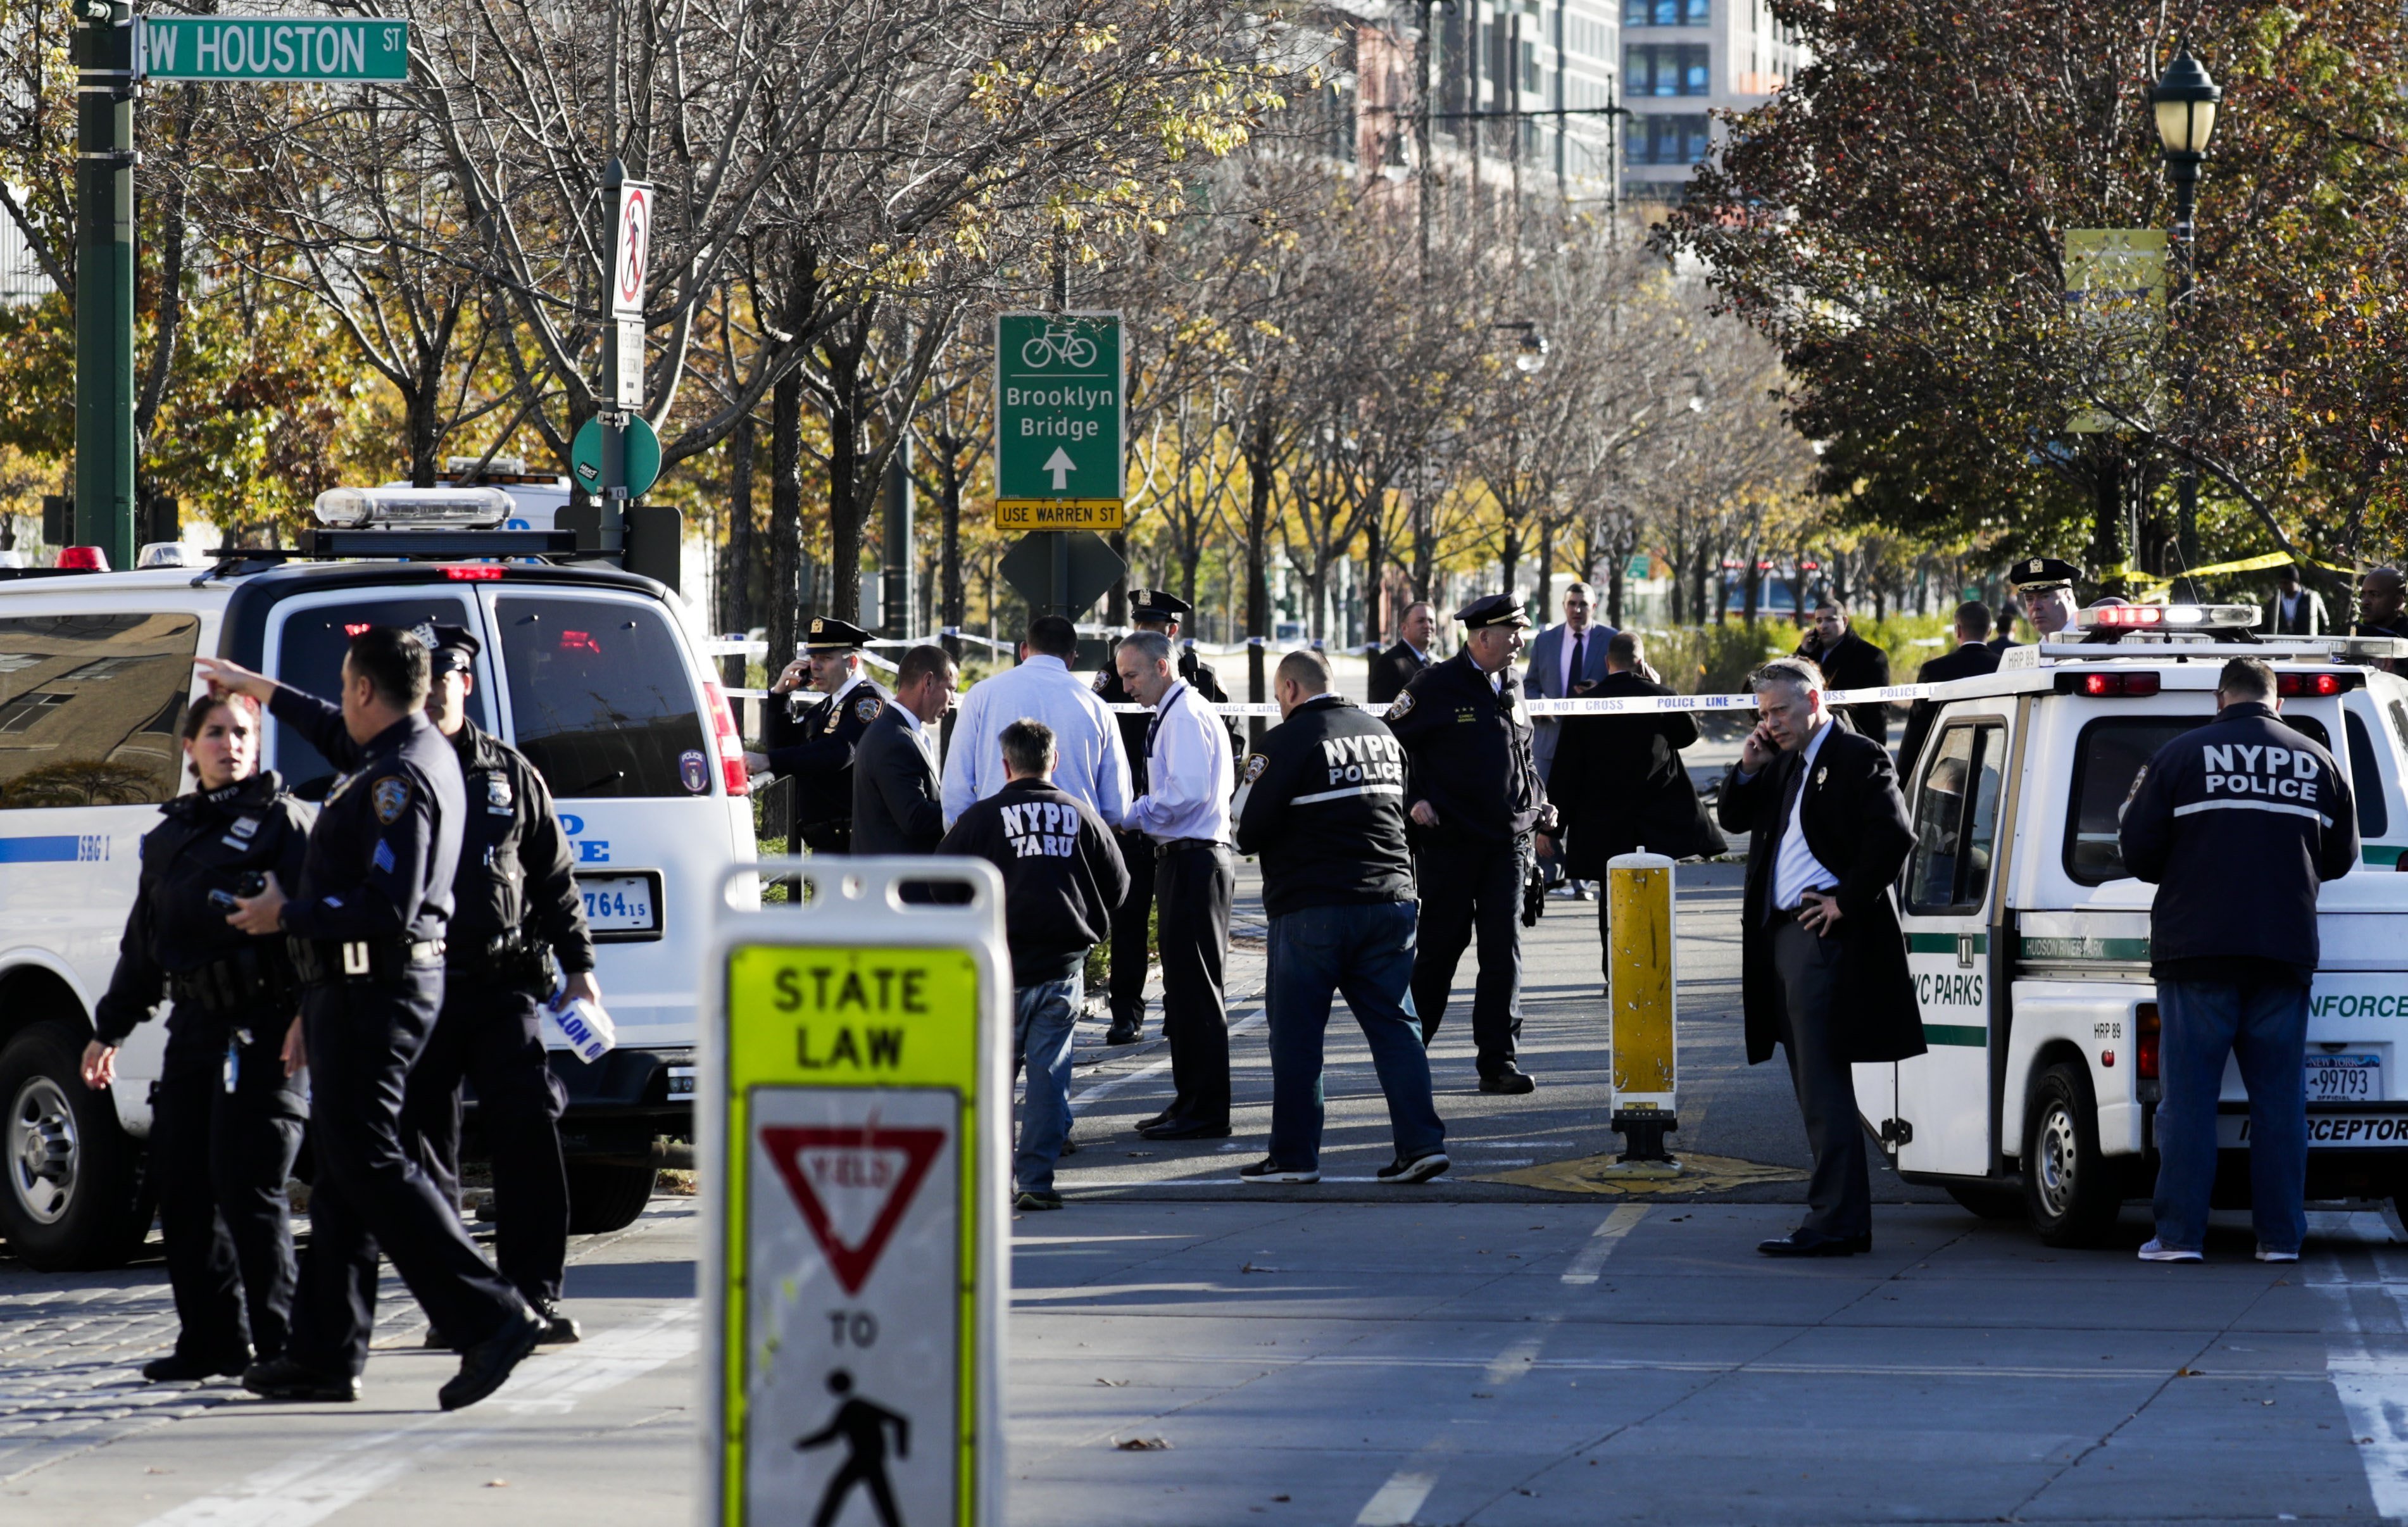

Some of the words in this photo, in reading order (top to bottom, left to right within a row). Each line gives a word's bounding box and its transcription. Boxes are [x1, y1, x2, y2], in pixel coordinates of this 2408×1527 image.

[149, 25, 178, 71] W
[197, 25, 365, 73] HOUSTON
[383, 28, 401, 51] ST
[1007, 386, 1113, 411] Brooklyn
[1021, 416, 1099, 441] Bridge
[1003, 507, 1029, 522] USE
[1036, 507, 1093, 522] WARREN
[1100, 507, 1116, 522] ST
[2008, 651, 2024, 669] HRP
[2025, 650, 2035, 667] 89
[1529, 702, 1545, 712] DO
[1553, 701, 1576, 711] NOT
[1585, 700, 1624, 711] CROSS
[1657, 698, 1695, 708] POLICE
[1706, 696, 1729, 707] LINE
[1879, 687, 1918, 698] POLICE
[1322, 734, 1401, 767] NYPD
[2203, 744, 2320, 780] NYPD
[1329, 762, 1403, 786] POLICE
[2205, 774, 2318, 802] POLICE
[1000, 802, 1079, 838] NYPD
[80, 835, 101, 862] SRG
[1010, 834, 1075, 858] TARU
[629, 903, 646, 917] 15
[2026, 939, 2057, 956] HUDSON
[2059, 939, 2082, 957] RIVER
[2084, 941, 2105, 957] PARK
[773, 966, 931, 1014] STATE
[1935, 974, 1983, 1007] PARKS
[556, 1011, 592, 1046] NOT
[2094, 1022, 2110, 1039] HRP
[2112, 1022, 2121, 1039] 89
[795, 1024, 905, 1070] LAW
[2309, 1057, 2330, 1067] NEW
[2333, 1057, 2358, 1067] YORK
[2319, 1069, 2367, 1094] 99793
[825, 1310, 879, 1348] TO
